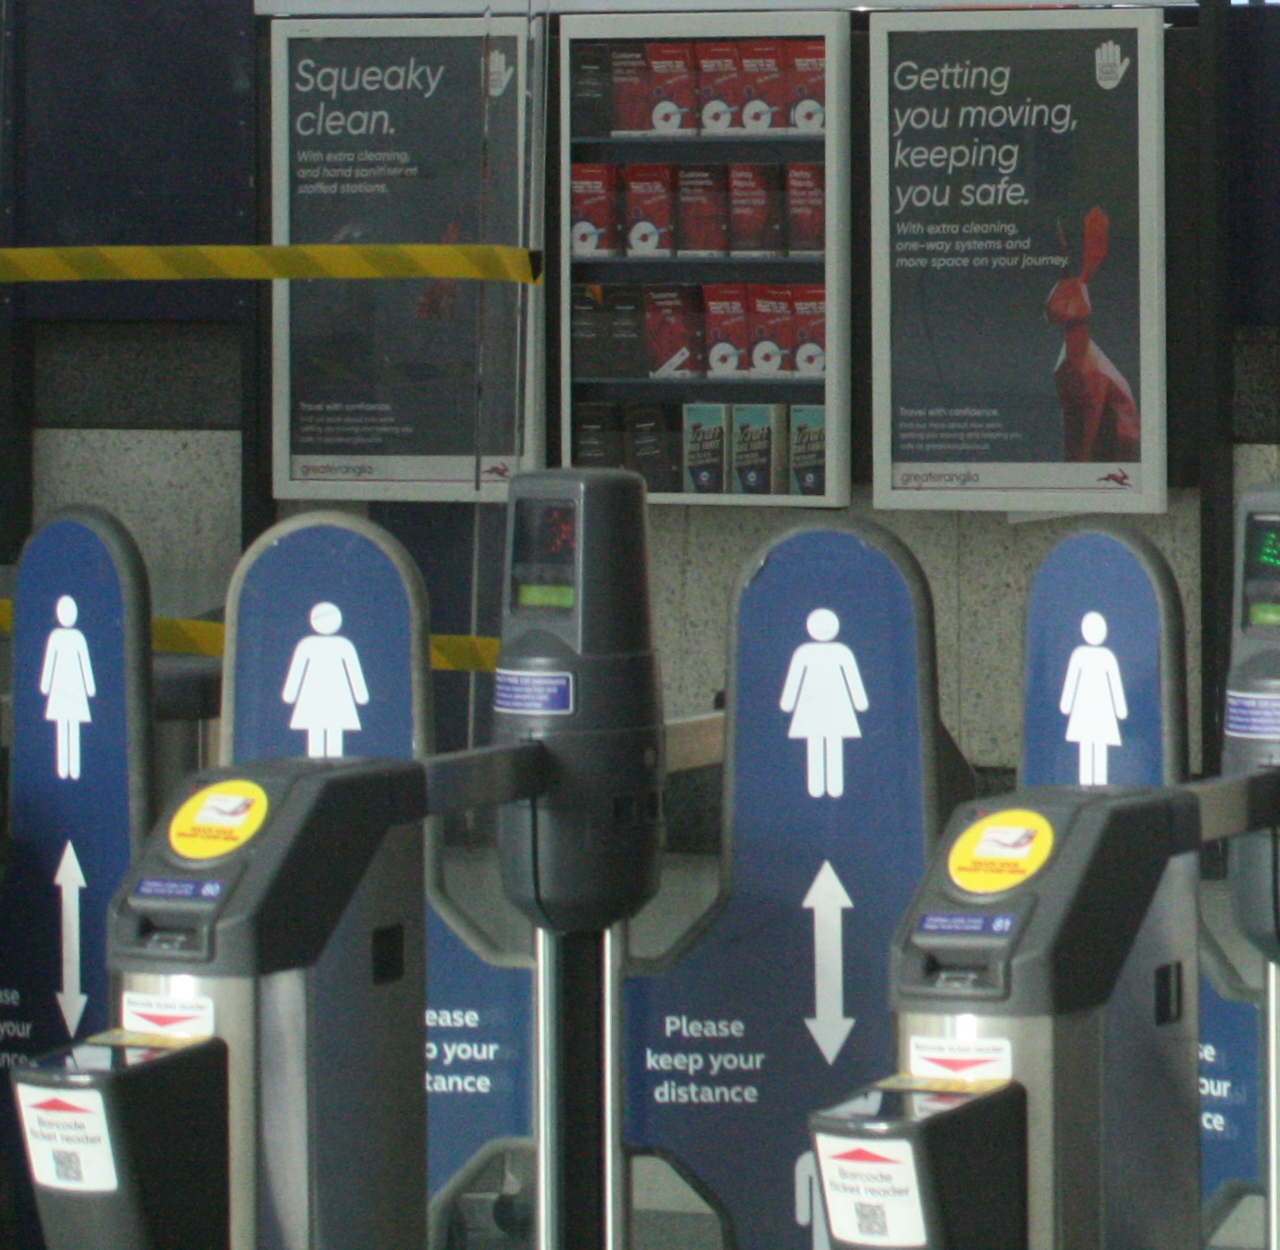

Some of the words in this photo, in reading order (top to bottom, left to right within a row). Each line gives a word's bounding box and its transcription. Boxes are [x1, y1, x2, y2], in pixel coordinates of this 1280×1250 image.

[295, 56, 445, 100] Squeaky
[893, 59, 1010, 96] Getting
[295, 101, 396, 136] clean.
[893, 107, 949, 137] you
[958, 97, 1077, 134] moving,
[297, 150, 324, 162] With
[326, 151, 354, 162] extra
[894, 138, 1019, 174] keeping
[297, 166, 320, 178] and
[322, 166, 352, 178] hand
[894, 184, 950, 215] you
[960, 176, 1030, 206] safe.
[896, 222, 924, 234] With
[927, 223, 959, 234] extra
[962, 222, 1019, 236] cleaning,
[896, 240, 951, 252] one-way
[954, 239, 1002, 252] systems
[1004, 238, 1031, 250] and
[896, 257, 928, 268] more
[930, 256, 969, 270] space
[972, 256, 988, 267] on
[991, 256, 1019, 269] your
[301, 462, 374, 477] greateranglia
[901, 471, 979, 486] greateranglia
[425, 1009, 479, 1027] ease
[665, 1015, 745, 1037] Please
[442, 1042, 499, 1065] your
[646, 1047, 704, 1076] keep
[708, 1052, 765, 1075] your
[425, 1071, 491, 1093] tance
[654, 1080, 759, 1103] distance
[37, 1115, 85, 1131] Barcode
